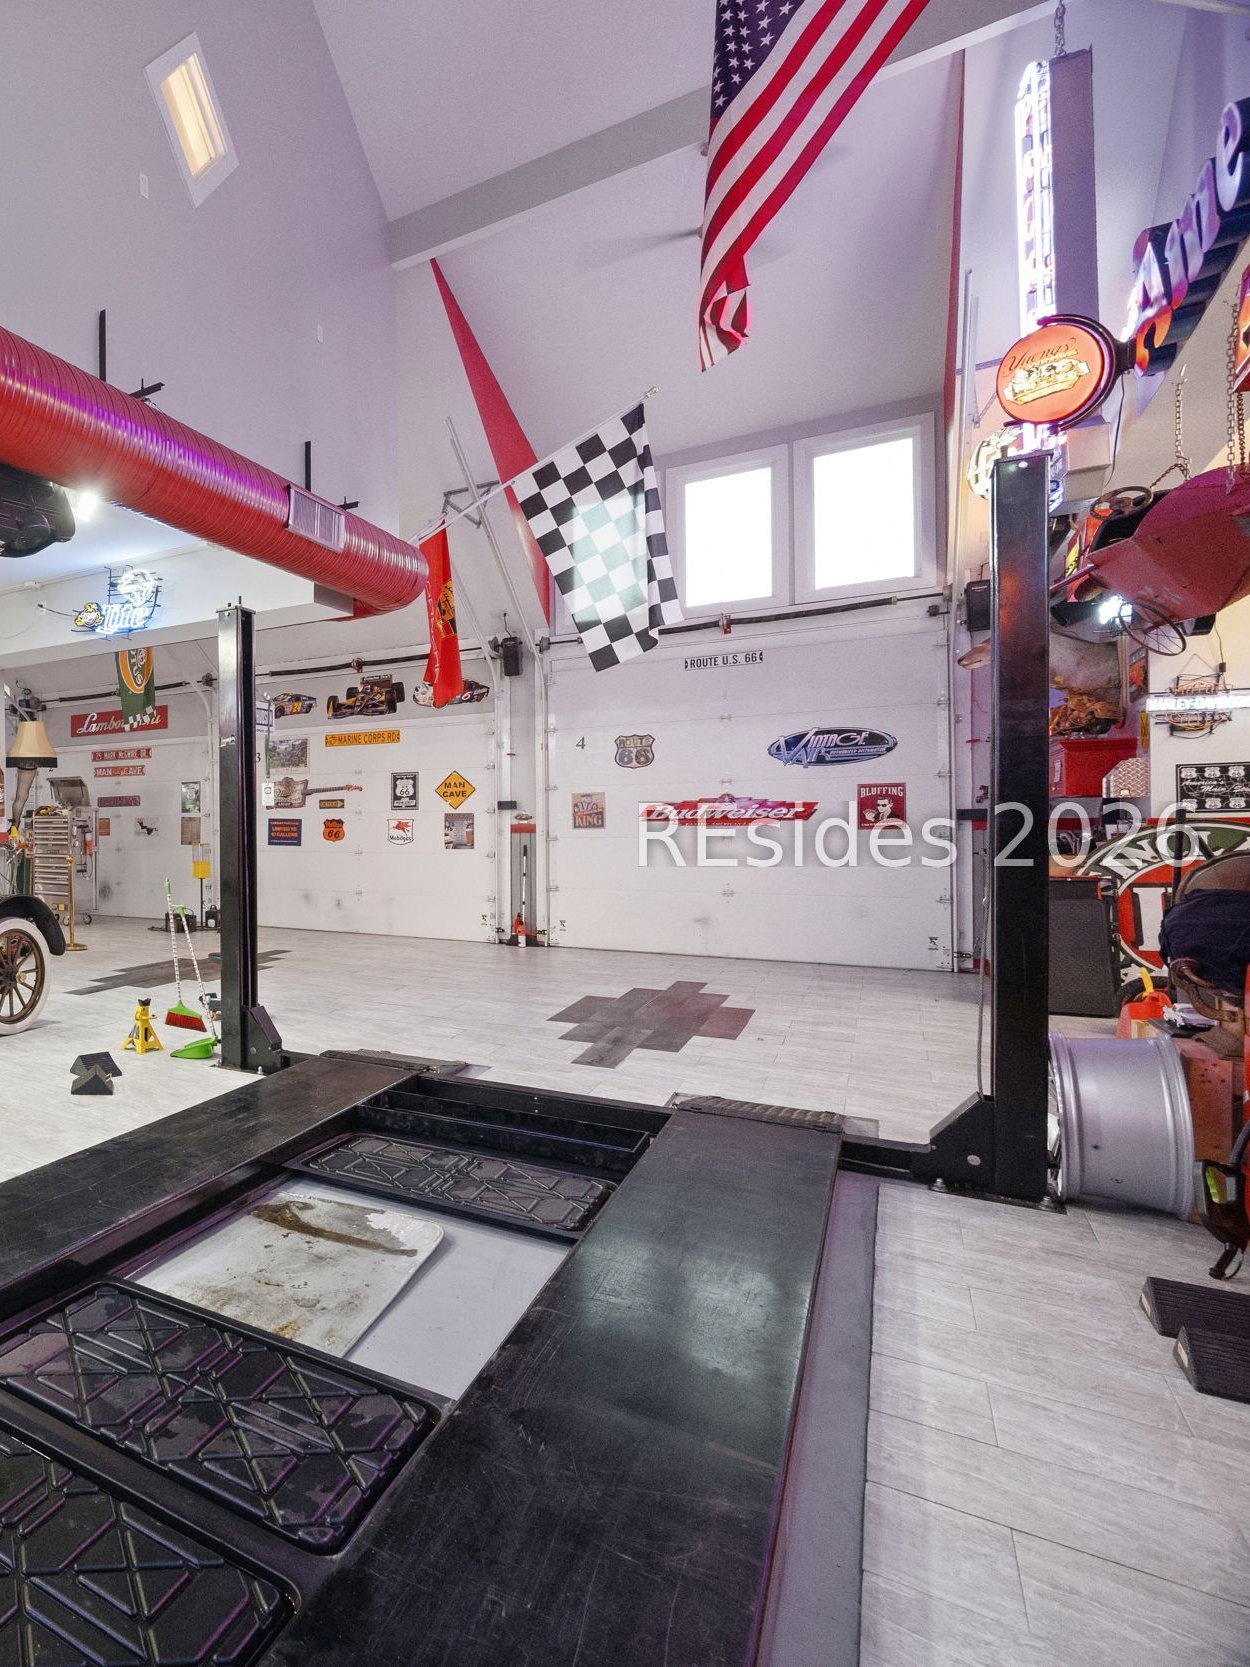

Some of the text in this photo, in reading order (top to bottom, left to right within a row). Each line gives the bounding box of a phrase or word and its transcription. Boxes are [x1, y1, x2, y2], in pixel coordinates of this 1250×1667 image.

[690, 652, 757, 669] ROUTE U.S. 66
[338, 731, 398, 745] MARINE CORPS RD.
[575, 736, 586, 750] 4
[618, 737, 651, 747] ROUTE
[618, 748, 651, 765] 66
[96, 766, 143, 776] MAN CAVE
[444, 781, 465, 789] MAN
[1200, 785, 1227, 793] Main
[399, 788, 410, 796] 66
[442, 790, 467, 798] CAVE
[860, 786, 903, 798] BLUFFING
[649, 804, 805, 820] Budweiser
[574, 814, 602, 827] KING
[327, 829, 341, 839] 66
[389, 834, 412, 843] Mobilgas
